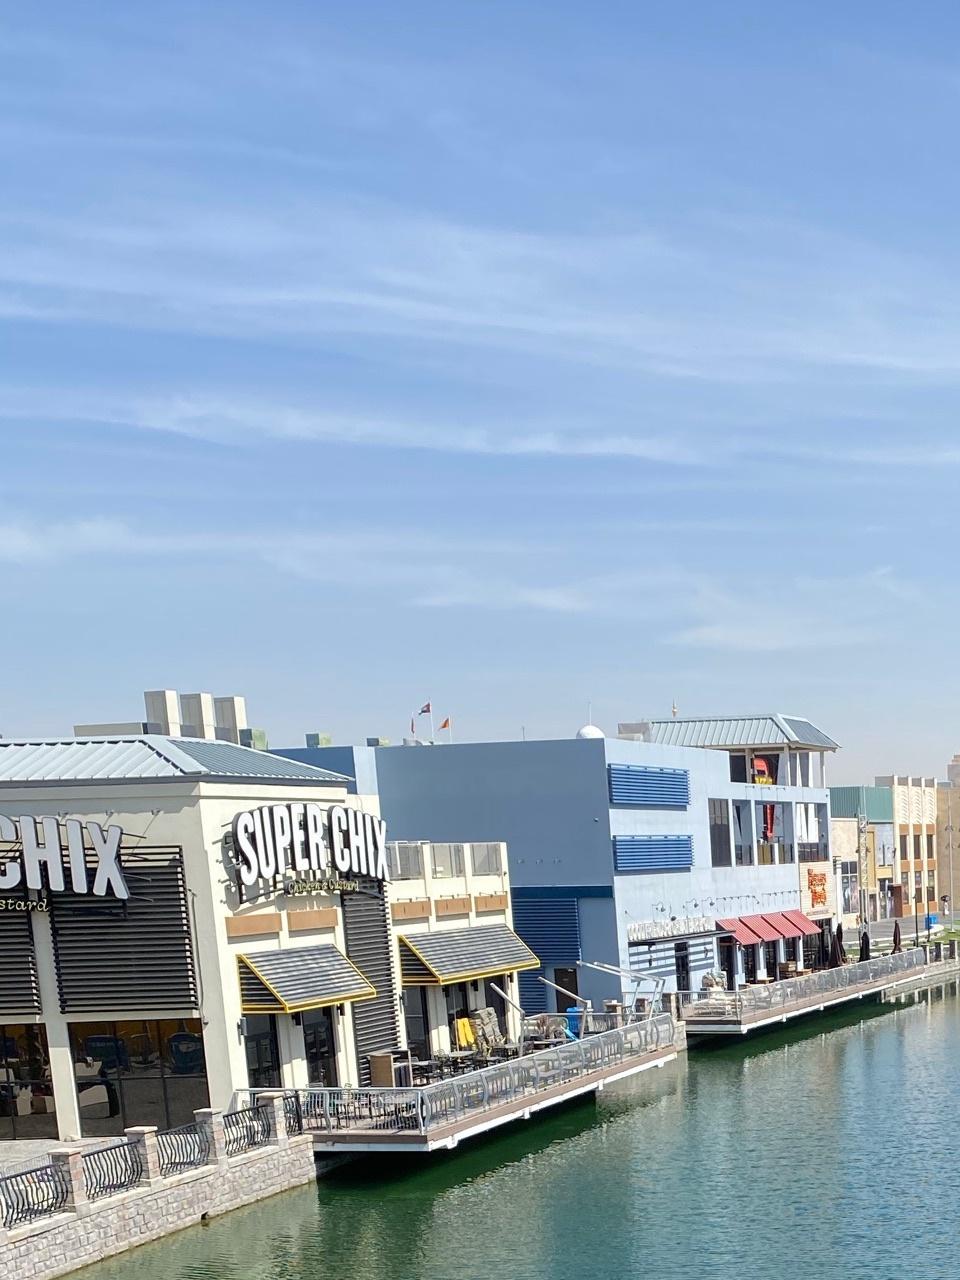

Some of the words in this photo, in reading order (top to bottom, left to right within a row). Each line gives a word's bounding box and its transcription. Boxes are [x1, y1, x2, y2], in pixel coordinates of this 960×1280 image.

[235, 803, 327, 885] SUPER
[330, 804, 390, 882] CHIX
[288, 880, 320, 893] Chicken
